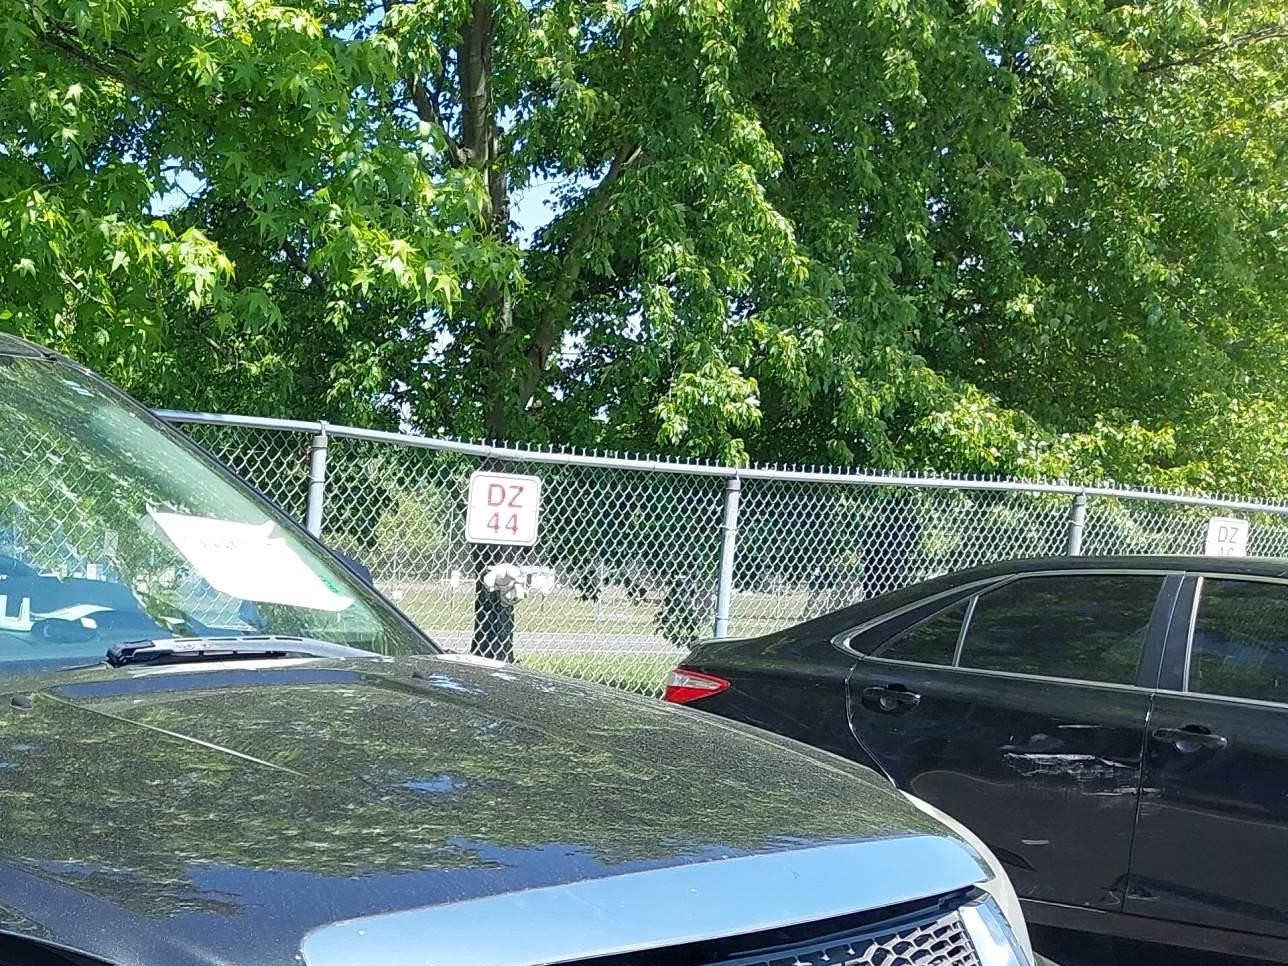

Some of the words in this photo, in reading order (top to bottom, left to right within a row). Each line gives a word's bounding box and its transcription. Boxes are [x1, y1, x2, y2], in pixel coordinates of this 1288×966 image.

[487, 483, 525, 508] DZ
[486, 511, 519, 535] 44
[1217, 526, 1240, 544] DZ
